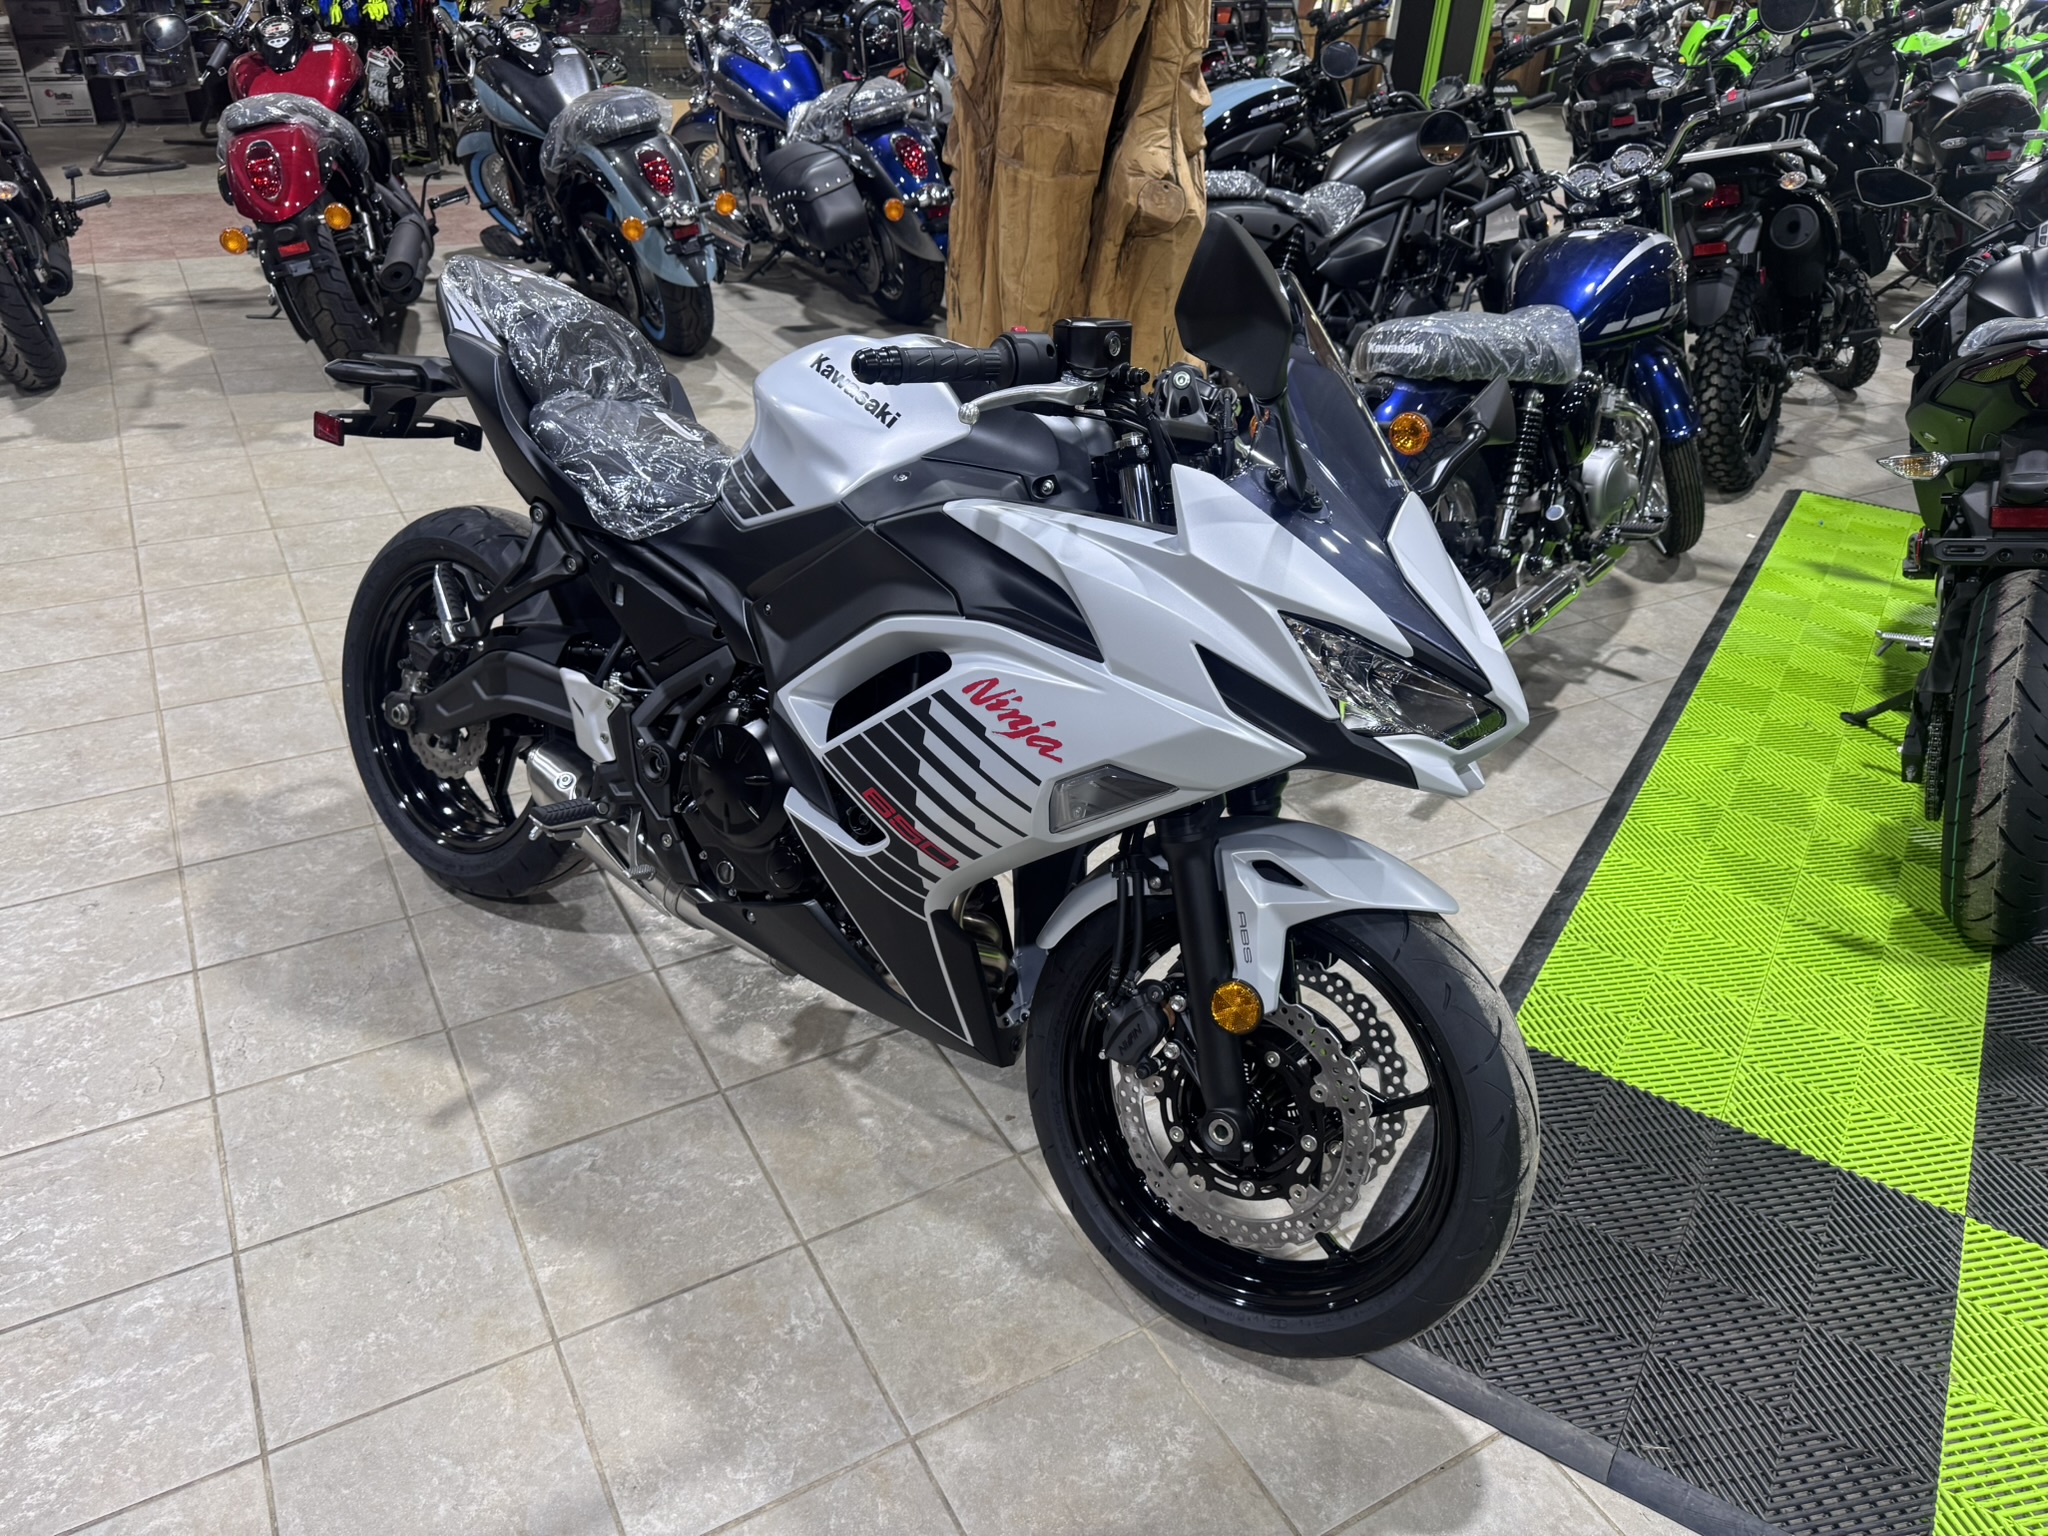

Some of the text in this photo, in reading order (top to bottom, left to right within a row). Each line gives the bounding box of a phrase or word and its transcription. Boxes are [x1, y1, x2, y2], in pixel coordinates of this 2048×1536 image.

[1368, 341, 1424, 354] Kawasaki
[809, 353, 902, 429] Kawasaki
[962, 677, 1063, 763] Ninja
[862, 786, 960, 868] 650
[1237, 911, 1253, 964] ABS
